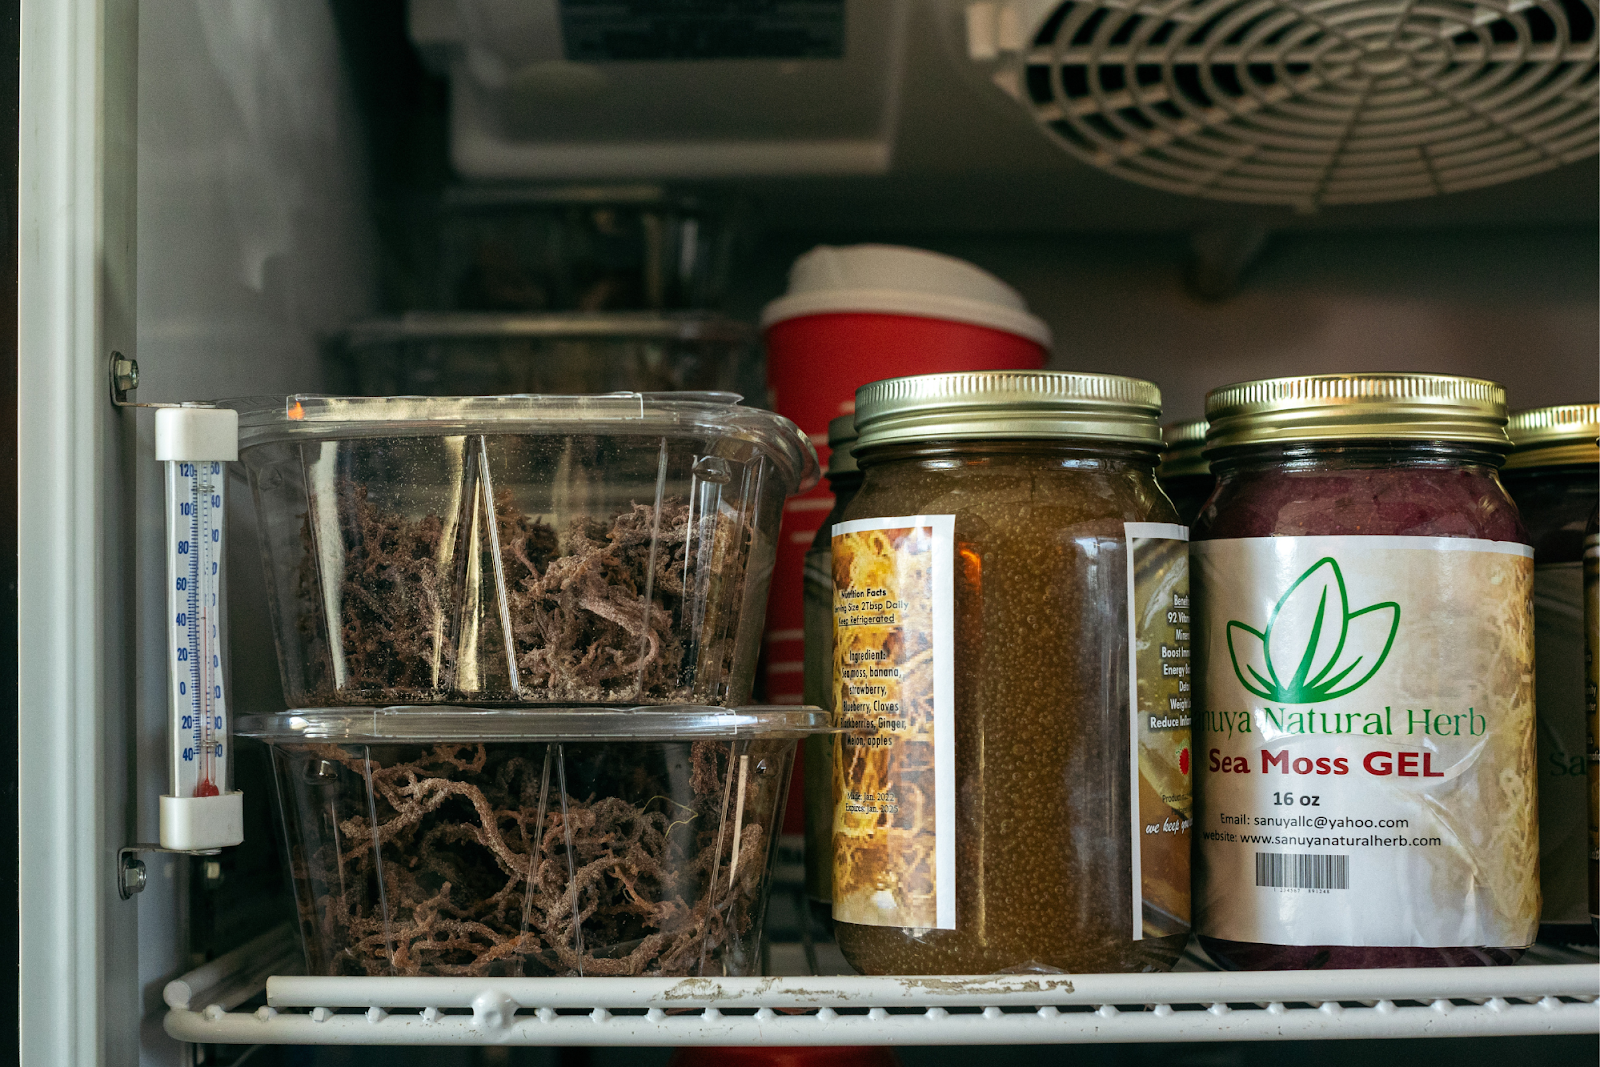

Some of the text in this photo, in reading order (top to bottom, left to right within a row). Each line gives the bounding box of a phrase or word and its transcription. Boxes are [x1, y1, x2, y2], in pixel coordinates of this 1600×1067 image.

[179, 463, 195, 478] 120
[179, 502, 195, 516] 100
[178, 540, 189, 555] 80
[176, 577, 187, 591] 60
[841, 588, 887, 599] Nutrition Facts
[848, 602, 859, 612] Size
[861, 601, 883, 612] 2Tbsp
[885, 600, 909, 611] Daily
[176, 612, 187, 626] 40
[838, 613, 895, 626] Keep Refrigerated
[1167, 611, 1178, 623] 92
[177, 647, 188, 662] 20
[1162, 646, 1181, 658] Boost
[869, 666, 902, 678] banana,
[1163, 663, 1185, 678] Energy
[180, 681, 186, 695] 0
[849, 683, 887, 697] strawberry,
[843, 700, 899, 714] Blueberry, Cloves
[182, 715, 192, 729] 20
[878, 717, 907, 731] Ginger,
[1150, 716, 1179, 728] Reduce
[1264, 706, 1393, 735] Natural
[1406, 707, 1486, 736] Herb
[867, 734, 893, 748] apples
[183, 747, 193, 761] 40
[1209, 748, 1445, 777] Sea Moss GEL
[877, 792, 896, 802] 2022
[1273, 792, 1320, 807] 16 oz
[1145, 823, 1160, 834] we
[1163, 816, 1180, 835] keep
[1220, 813, 1409, 830] Email: sanuyallc@yahoo.com
[1202, 830, 1441, 848] website: www.sanuyanaturalherb.com
